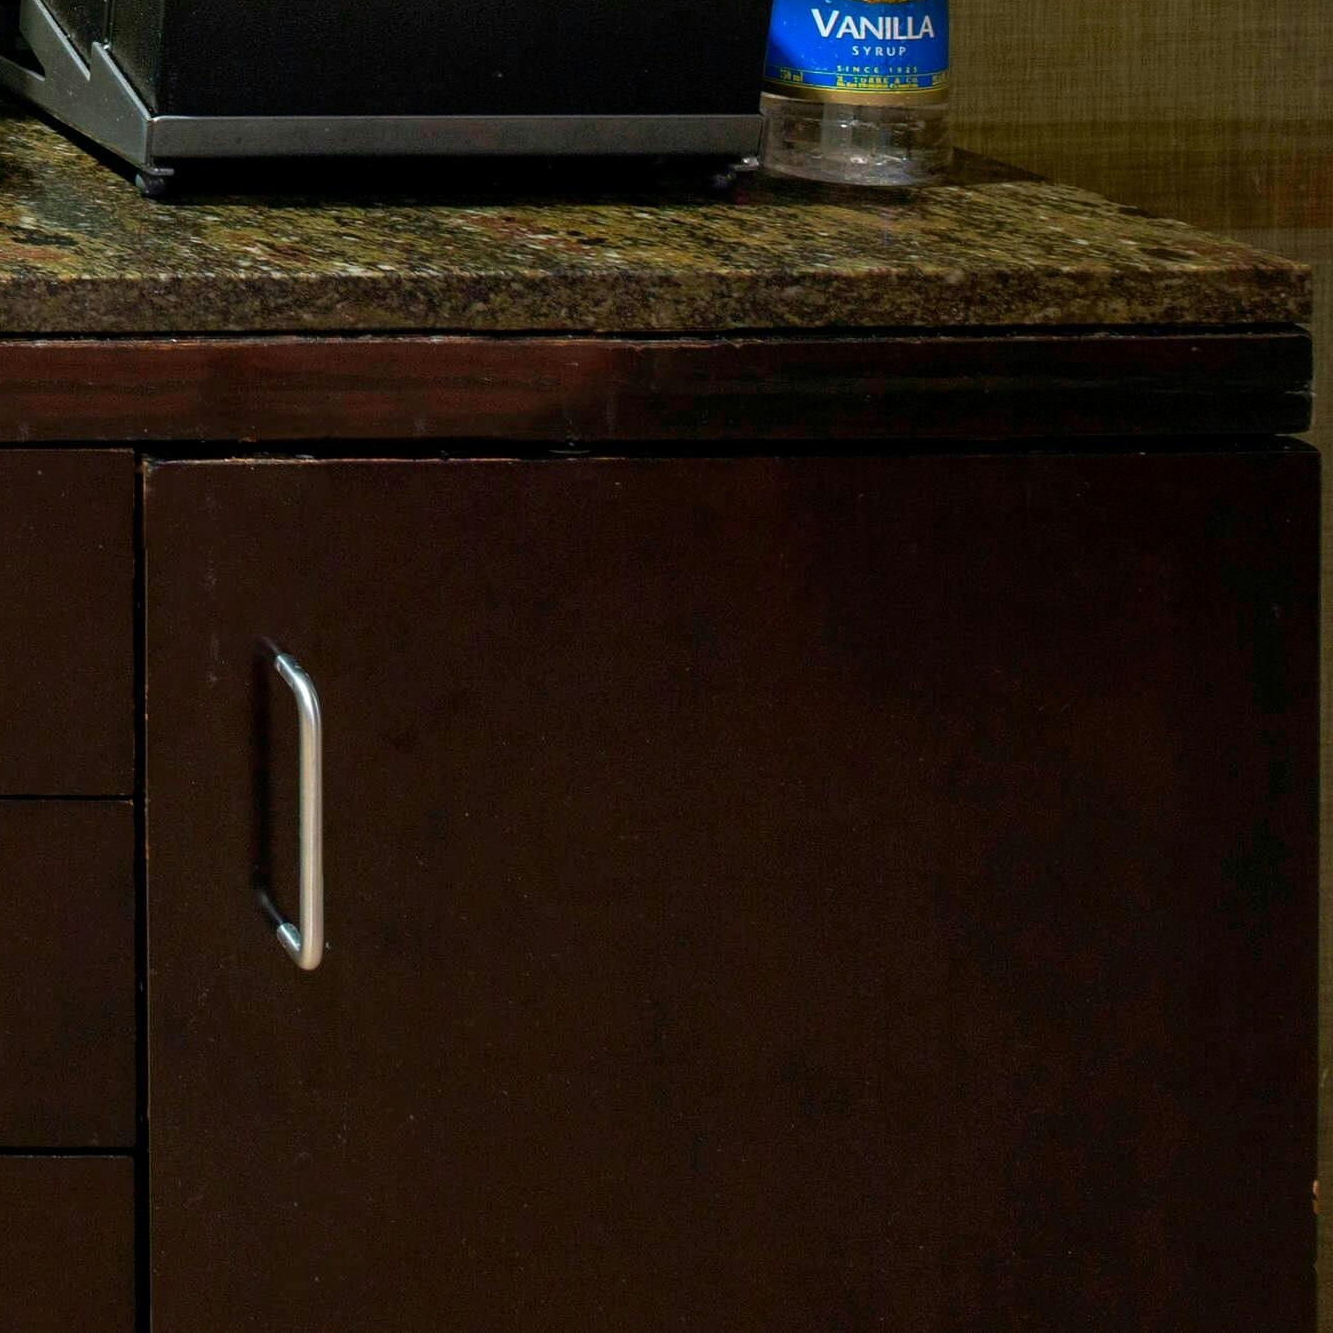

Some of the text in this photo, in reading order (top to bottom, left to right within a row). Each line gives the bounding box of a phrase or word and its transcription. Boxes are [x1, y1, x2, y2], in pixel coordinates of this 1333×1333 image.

[811, 8, 935, 40] VANILLA
[852, 44, 907, 57] SYRUP
[837, 65, 879, 74] SINCE
